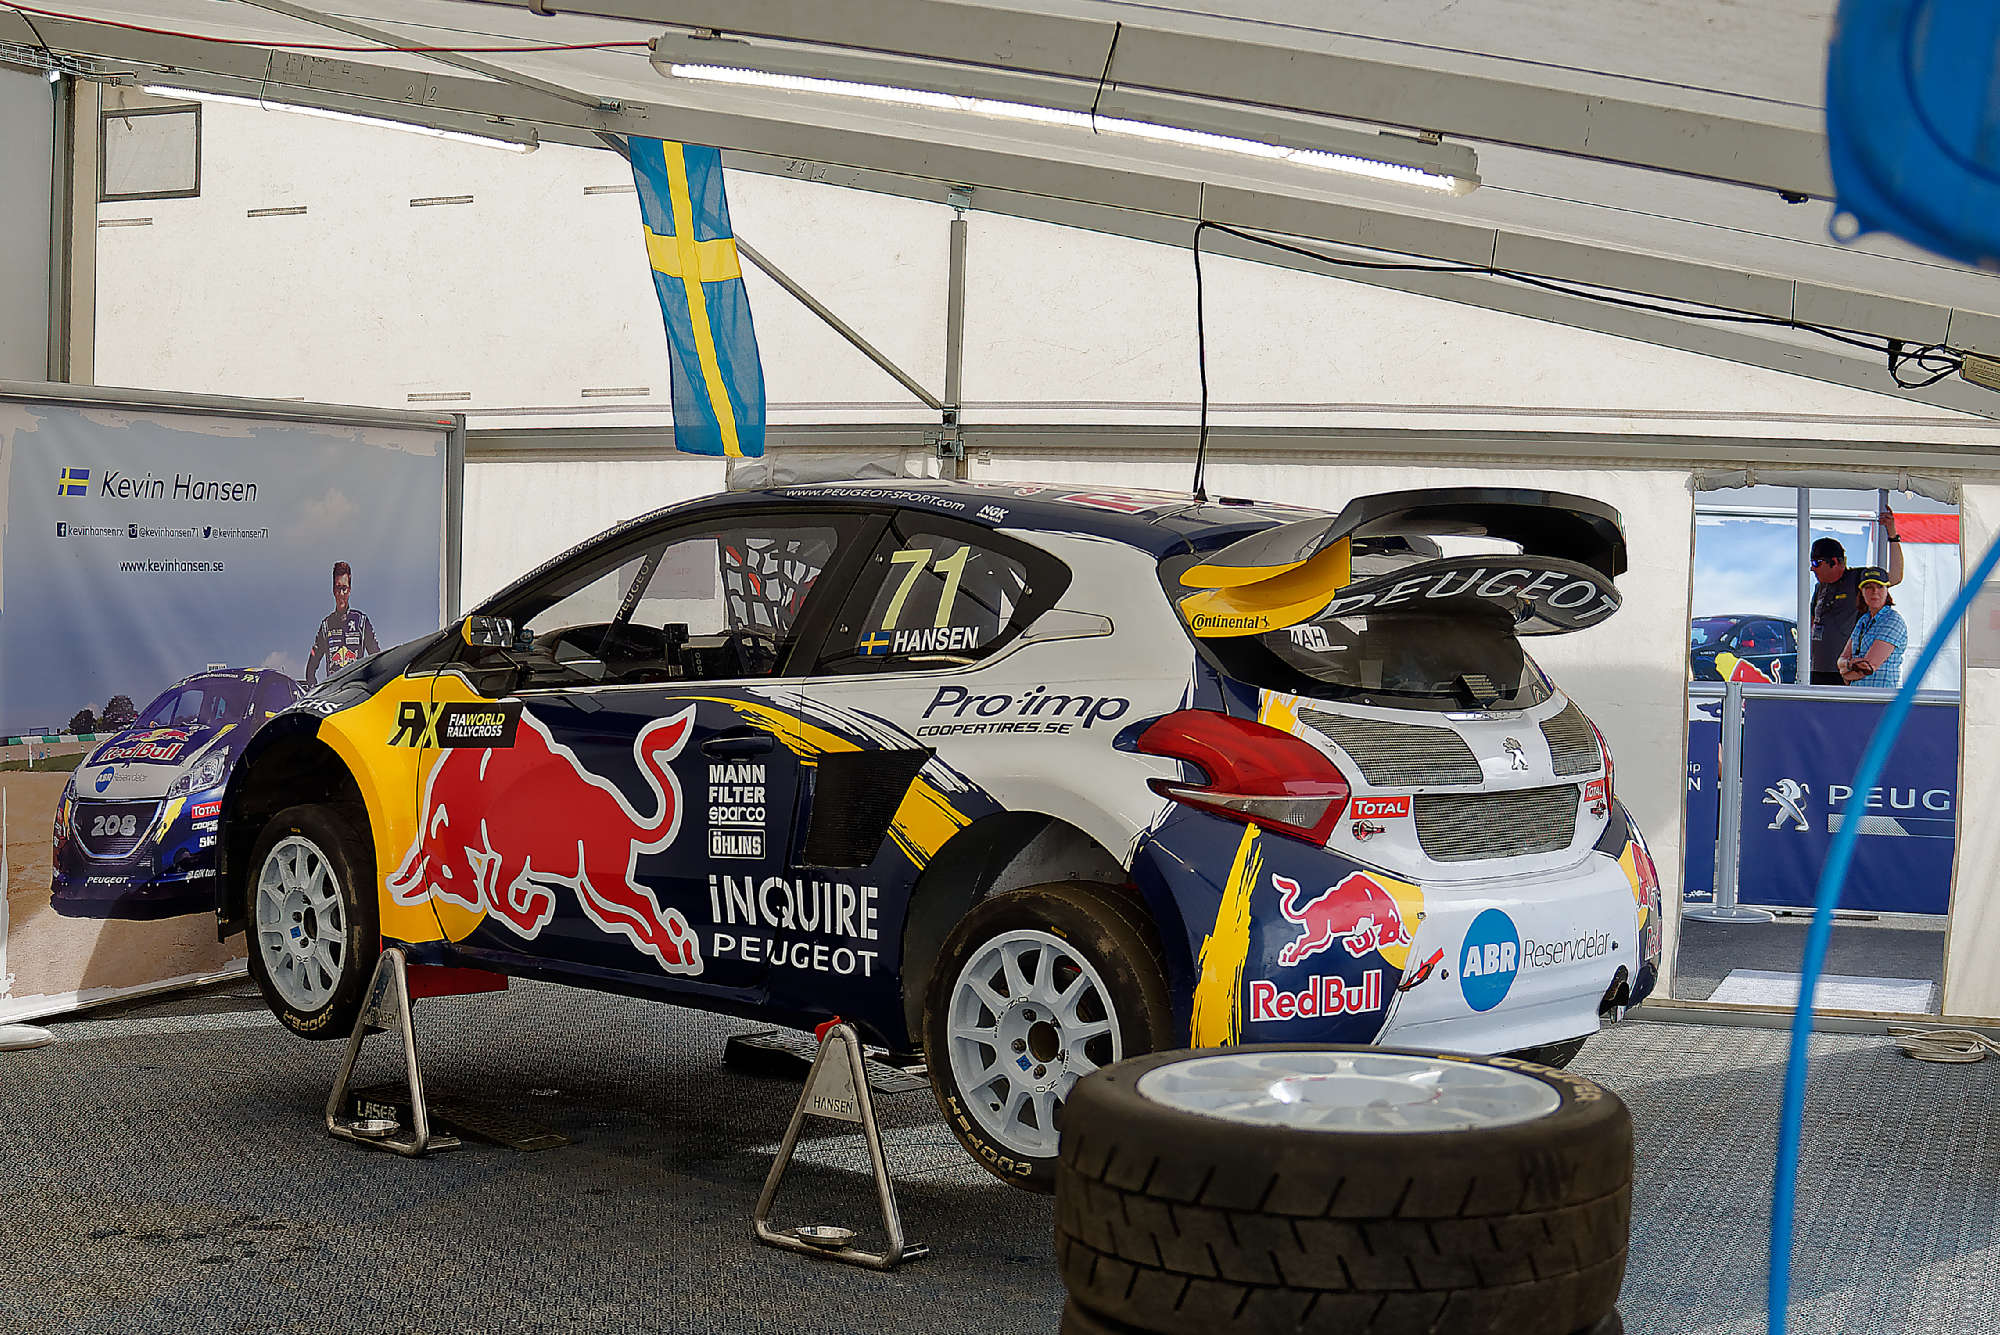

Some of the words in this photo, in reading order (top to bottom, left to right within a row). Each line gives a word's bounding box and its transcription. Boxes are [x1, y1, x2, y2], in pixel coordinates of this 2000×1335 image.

[101, 471, 164, 499] Kevin
[172, 473, 257, 502] Hansen
[786, 487, 966, 512] www.PEUGEOT-SPORT.com
[981, 504, 1010, 520] NGK
[68, 525, 124, 537] kevinhansenrx
[139, 527, 199, 538] @kevinhansen71
[212, 528, 269, 539] @kevinhansen71
[119, 559, 224, 572] www.kevinhansen.se
[880, 545, 971, 630] 71
[1311, 568, 1619, 621] PEUGEOT
[1191, 613, 1260, 631] Continental
[892, 626, 979, 653] HANSEN
[446, 726, 502, 737] RALLYCROSS
[917, 722, 1073, 737] COOPERTIRES.SE
[709, 764, 766, 784] MANN
[709, 786, 766, 803] FILTER
[1828, 784, 1951, 811] PEUG
[91, 814, 137, 837] 208
[709, 806, 766, 825] sparco
[712, 831, 762, 855] ÖHLINS
[87, 876, 129, 884] PEUGEOT
[713, 932, 878, 977] PEUGEOT
[1523, 928, 1611, 969] Reservdelar
[1463, 941, 1517, 978] ABR
[357, 1100, 397, 1121] LASER
[813, 1094, 853, 1115] HANSEN
